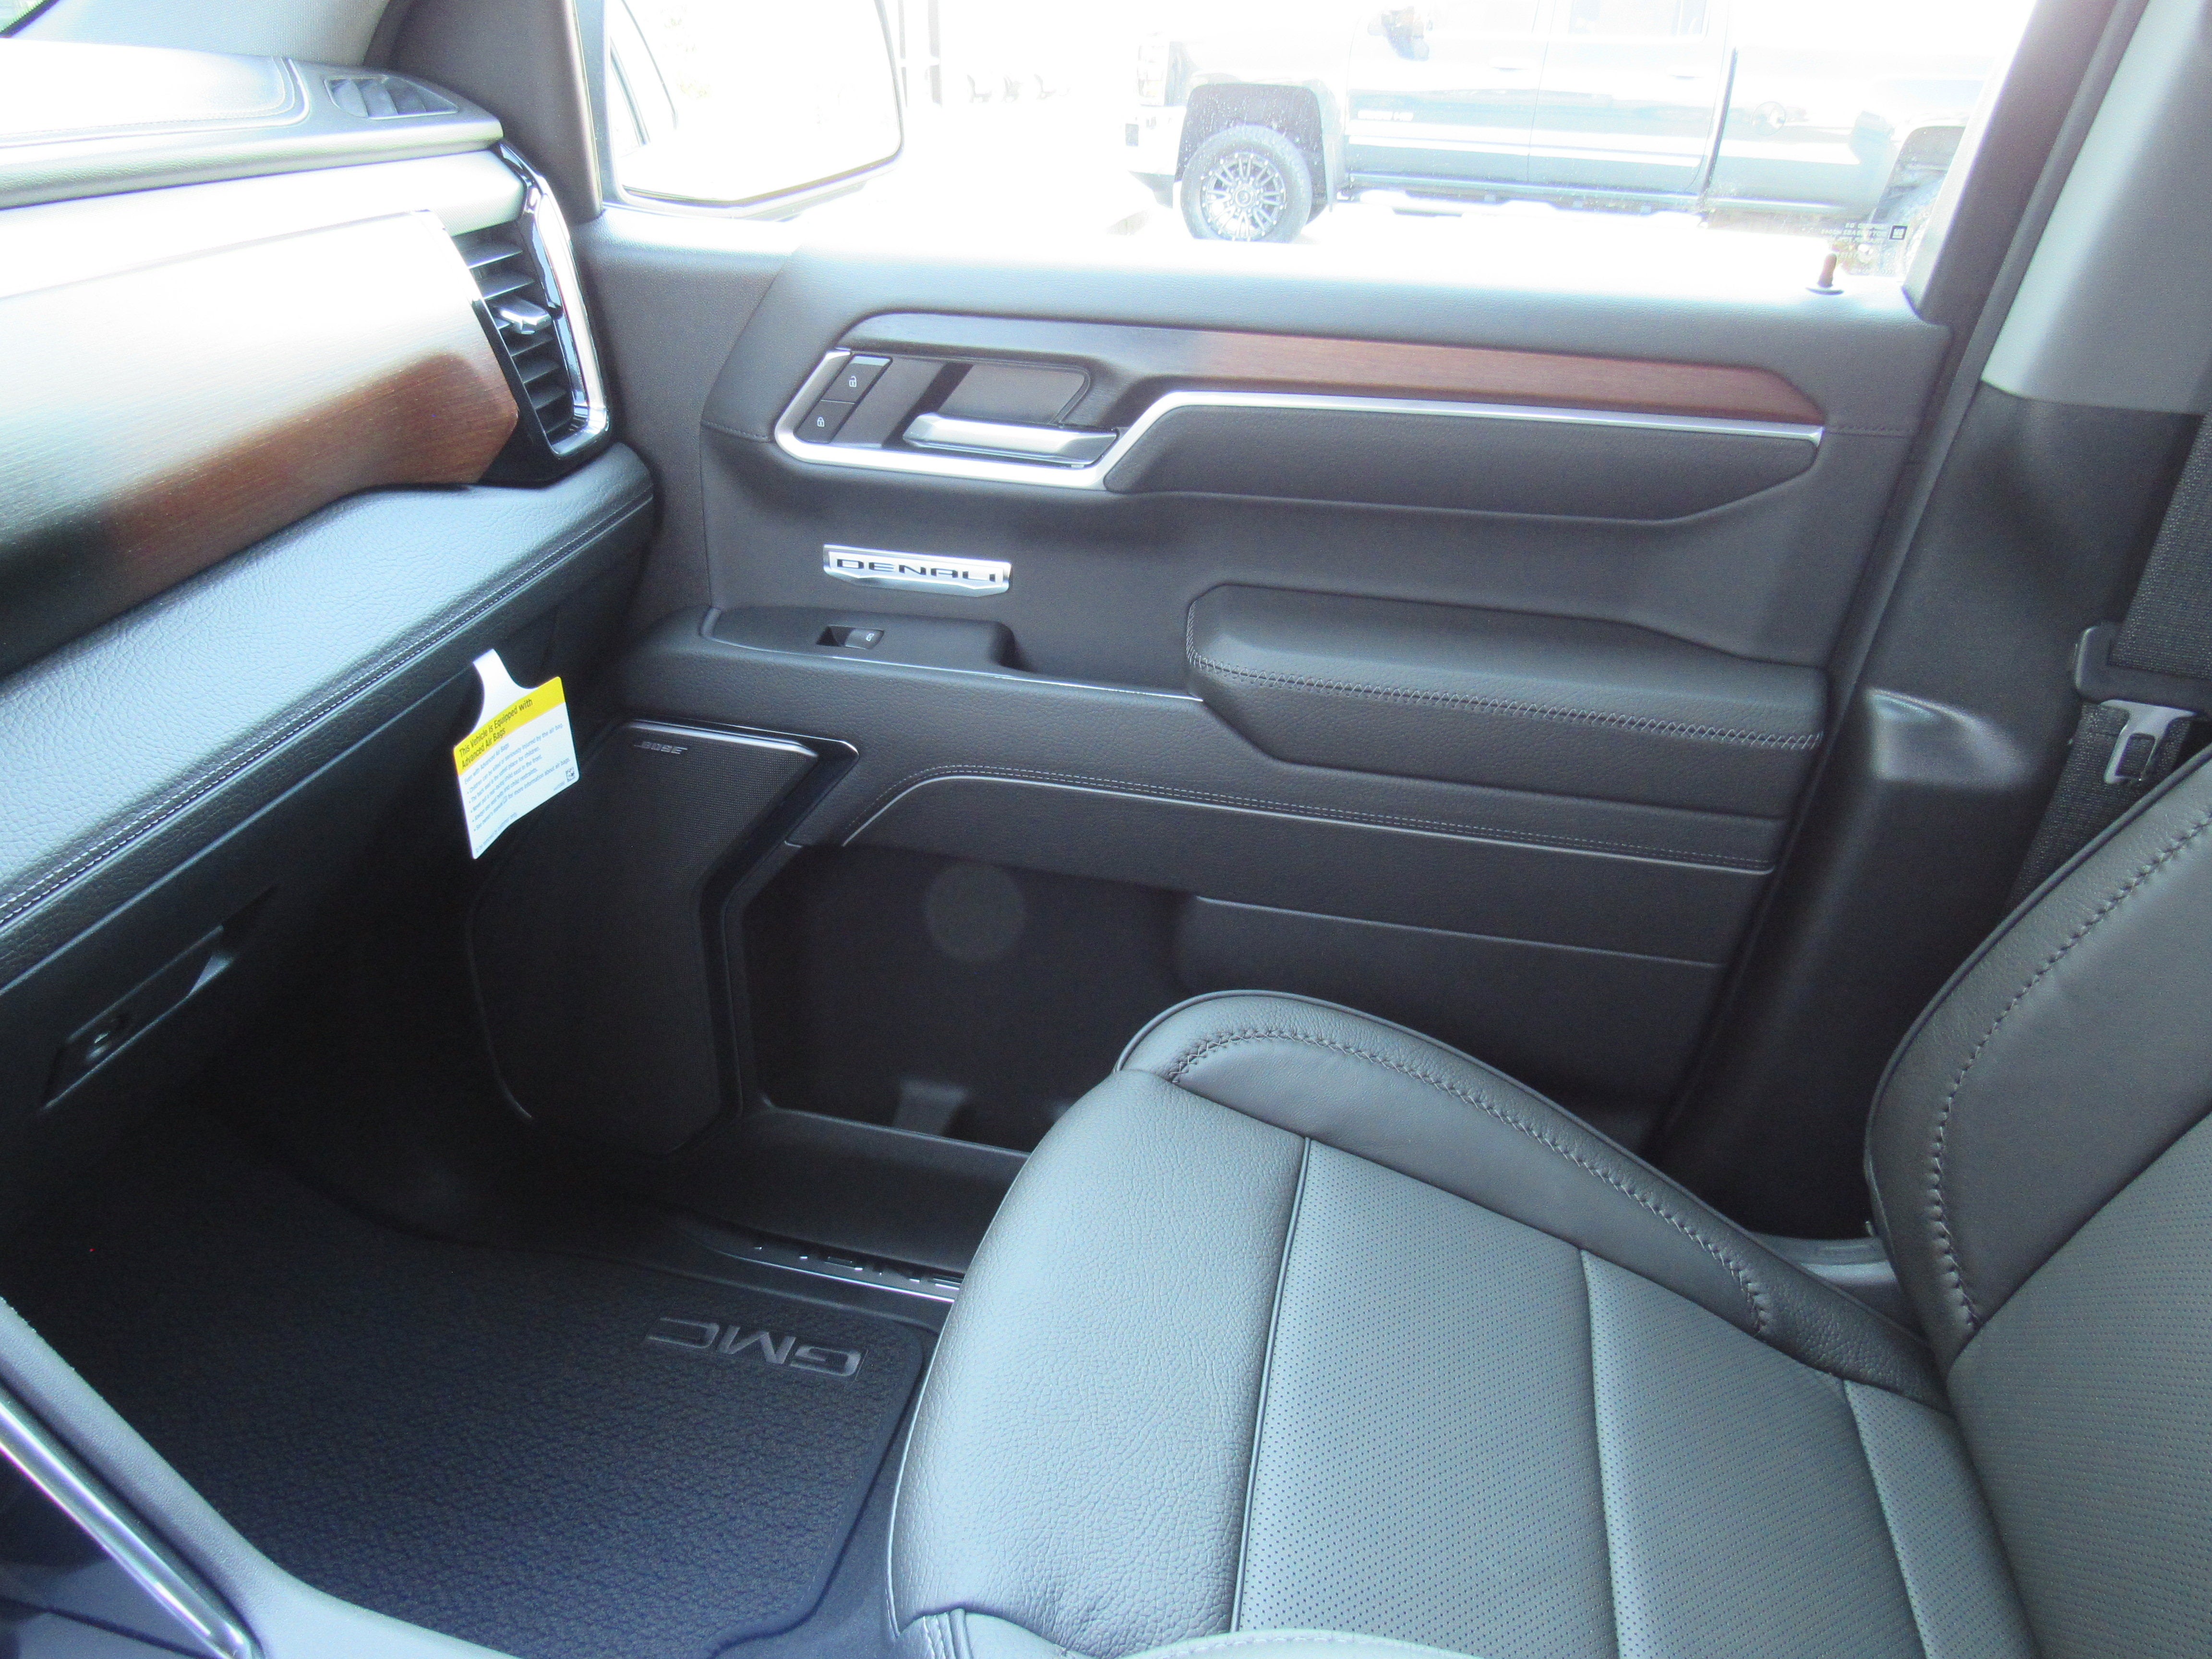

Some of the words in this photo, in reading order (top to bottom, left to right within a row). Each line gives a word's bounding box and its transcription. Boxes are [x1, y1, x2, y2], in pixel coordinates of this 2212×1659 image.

[837, 559, 996, 582] DENALI
[459, 745, 470, 757] This
[470, 729, 488, 748] Vehicle
[493, 706, 518, 729] Equipped
[518, 698, 533, 711] with
[462, 745, 485, 769] Advanced
[493, 728, 505, 742] Bags
[644, 1317, 862, 1377] GMC
